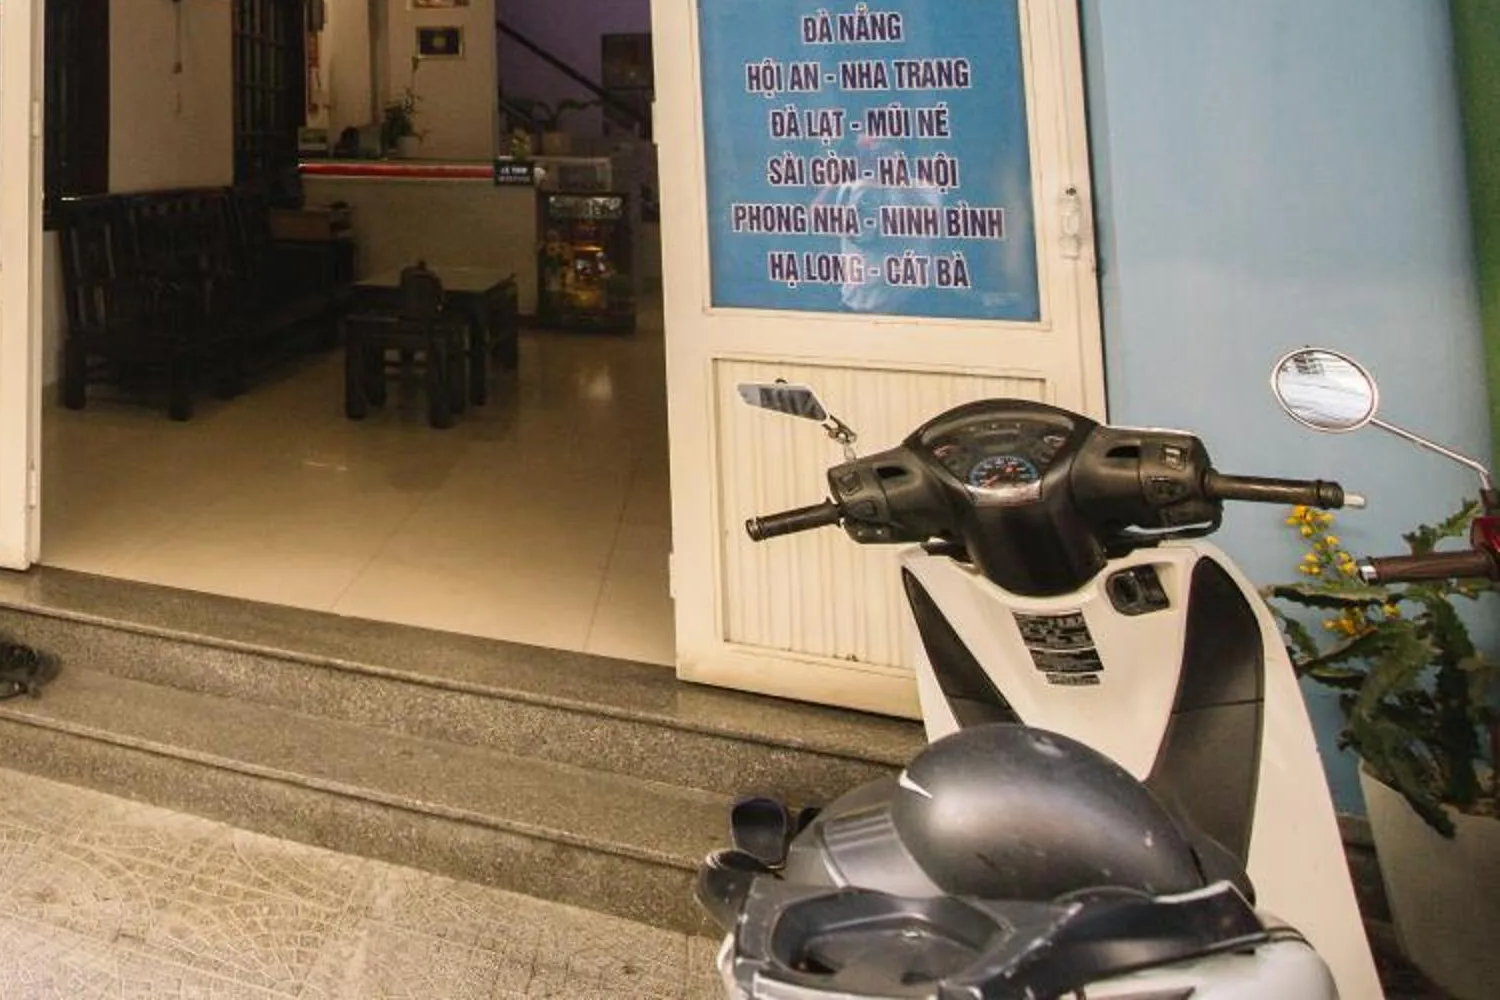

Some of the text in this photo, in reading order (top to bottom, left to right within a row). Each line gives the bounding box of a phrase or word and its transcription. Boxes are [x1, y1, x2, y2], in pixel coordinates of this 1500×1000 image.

[802, 8, 833, 44] ĐÀ
[746, 58, 783, 98] HỘI
[788, 62, 820, 92] AN
[839, 59, 890, 91] NHA
[892, 58, 971, 90] TRANG
[769, 103, 802, 139] ĐÀ
[805, 109, 846, 145] LẠT
[866, 102, 912, 139] MŨI
[916, 101, 950, 139] NÉ
[768, 152, 806, 187] SÀI
[810, 150, 859, 187] GÒN
[877, 151, 911, 186] HÀ
[915, 152, 960, 195] NỘI
[731, 203, 809, 234] PHONG
[811, 204, 862, 236] NHA
[879, 205, 941, 238] NINH
[944, 201, 1005, 240] BÌNH
[768, 251, 800, 288] HẠ
[802, 253, 866, 284] LONG
[884, 250, 931, 287] CÁT
[934, 251, 971, 288] BÀ
